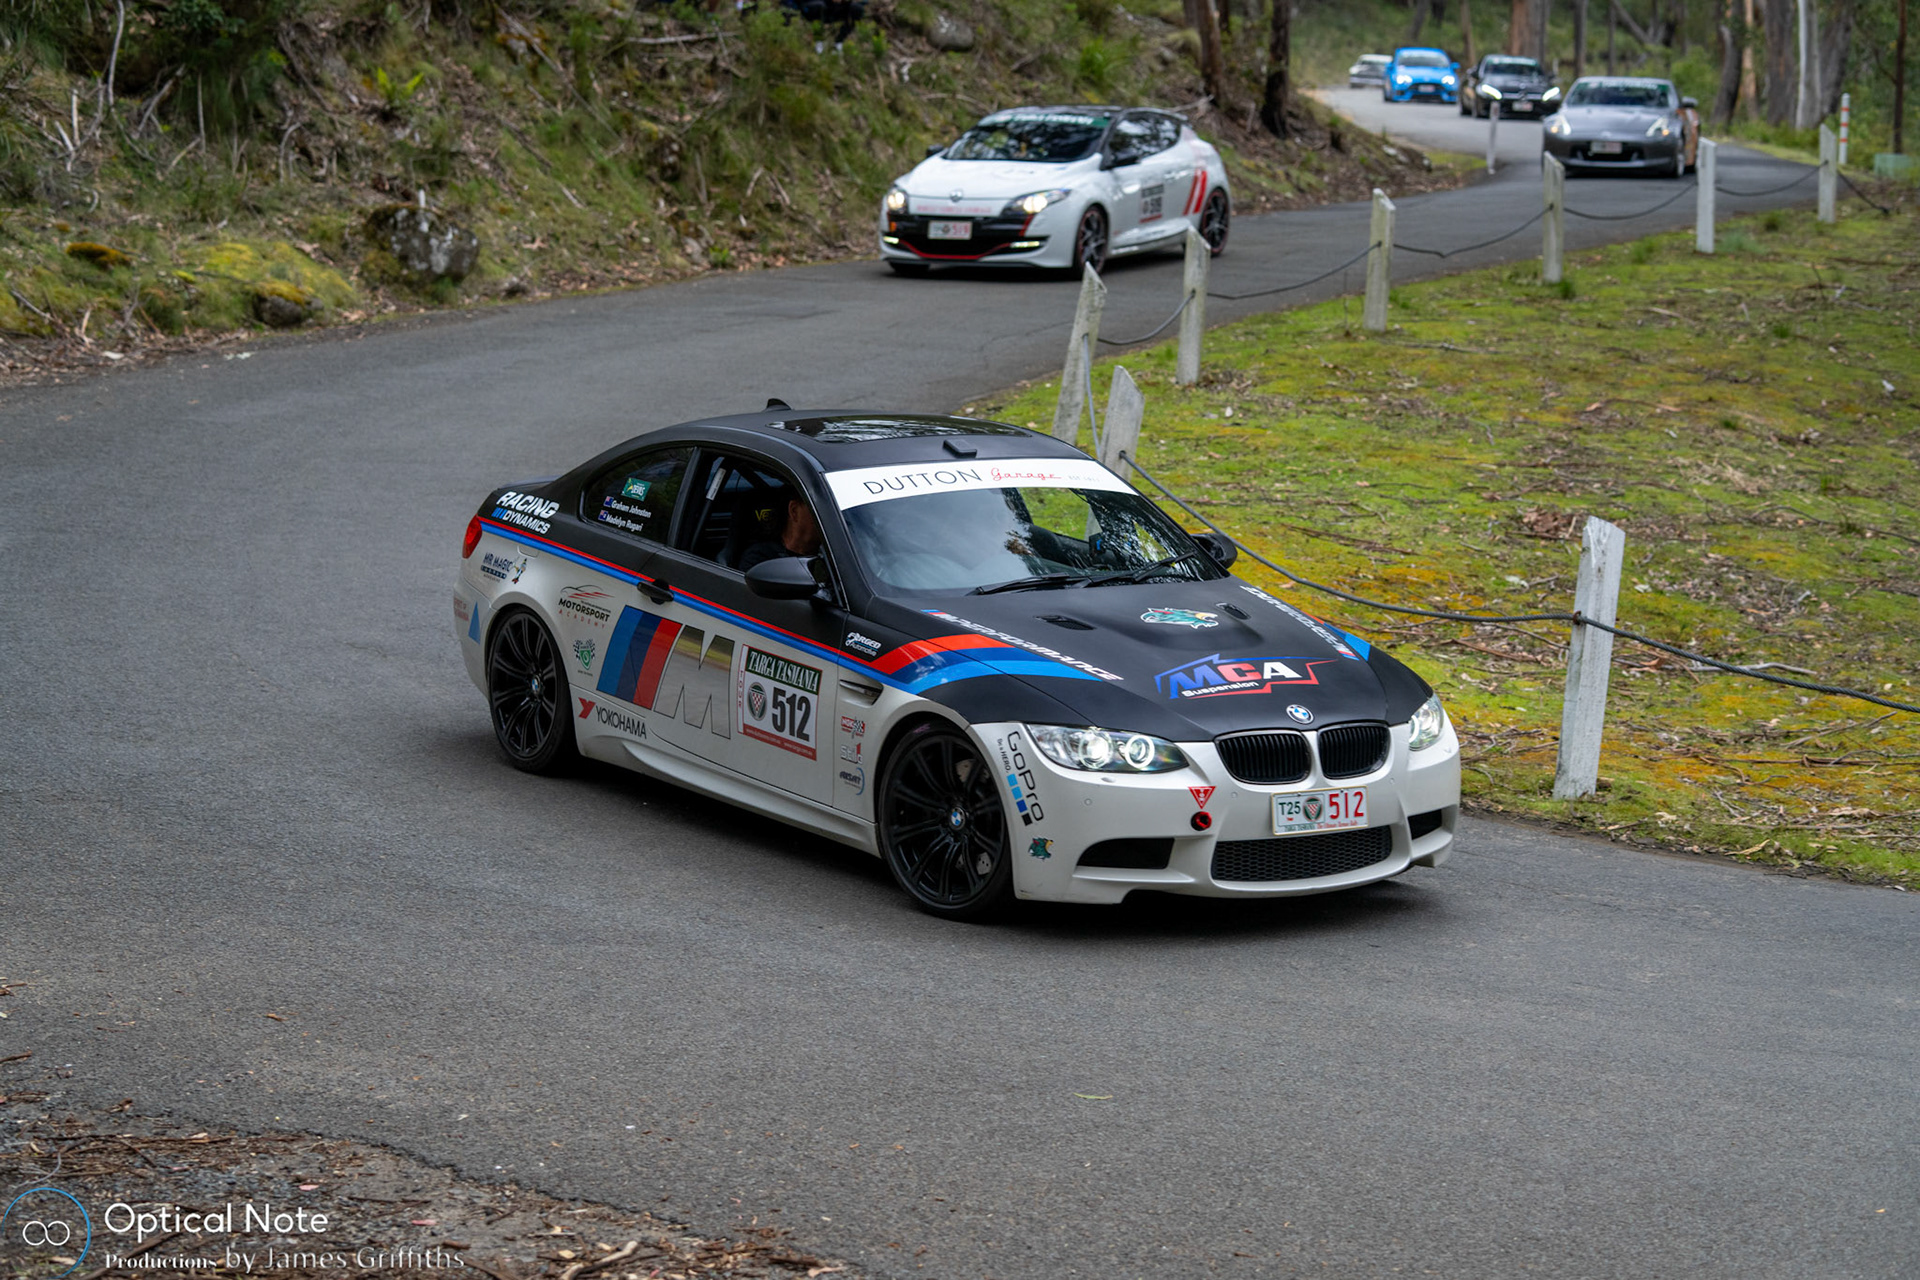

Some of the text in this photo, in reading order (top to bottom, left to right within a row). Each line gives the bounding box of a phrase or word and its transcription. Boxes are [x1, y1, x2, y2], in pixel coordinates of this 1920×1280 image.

[863, 468, 983, 495] DUTTON
[990, 467, 1062, 482] Garage
[496, 491, 560, 519] RACING
[503, 509, 551, 535] DYNAMICS
[558, 598, 611, 622] MOTORSPORT
[653, 624, 735, 740] M
[749, 652, 820, 692] TARGA TASMANIA
[1170, 661, 1302, 699] MCA
[1182, 681, 1259, 698] Suspension
[595, 705, 647, 740] YOKOHAMA
[772, 686, 811, 742] 512
[1007, 731, 1044, 821] GoPro
[1278, 801, 1300, 815] T25
[1329, 791, 1364, 819] 512
